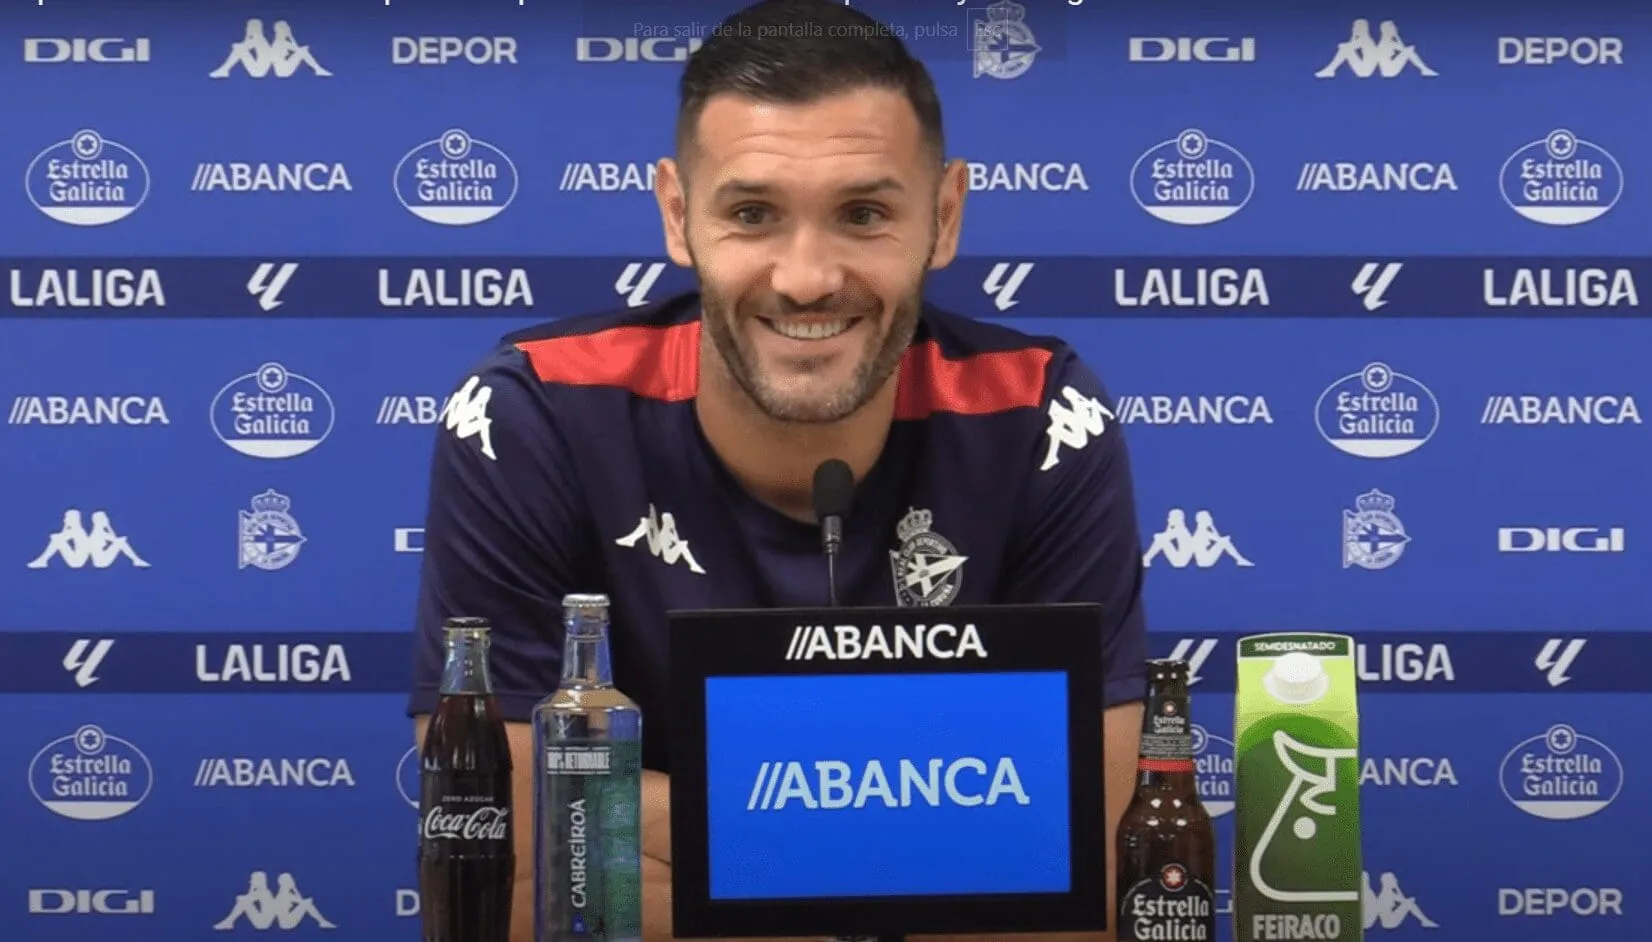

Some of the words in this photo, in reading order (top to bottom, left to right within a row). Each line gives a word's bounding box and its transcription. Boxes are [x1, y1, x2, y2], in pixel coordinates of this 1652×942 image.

[24, 38, 150, 62] DIGI
[392, 37, 518, 65] DEPOR
[1129, 37, 1255, 62] DIGI
[1498, 37, 1623, 65] DEPOR
[47, 159, 129, 180] Estrella
[415, 159, 497, 180] Estrella
[967, 162, 1089, 191] BANCA
[1151, 159, 1233, 180] Estrella
[1520, 159, 1602, 180] Estrella
[49, 181, 124, 203] Galicia
[418, 181, 493, 203] Galicia
[1154, 180, 1229, 202] Galicia
[1523, 180, 1598, 202] Galicia
[11, 268, 165, 307] LALIGA
[379, 268, 533, 307] LALIGA
[1115, 268, 1269, 307] LALIGA
[1484, 268, 1638, 307] LALIGA
[231, 392, 313, 413] Estrella
[1336, 392, 1418, 413] Estrella
[235, 414, 310, 436] Galicia
[1339, 413, 1414, 435] Galicia
[1498, 527, 1624, 552] DIGI
[1254, 642, 1336, 652] SEMIDESNATADO
[196, 644, 351, 682] LALIGA
[1357, 643, 1454, 681] LIGA
[50, 754, 131, 775] Estrella
[1359, 757, 1459, 786] ANCA
[1520, 754, 1602, 774] Estrella
[52, 776, 128, 797] Galicia
[1523, 775, 1598, 796] Galicia
[28, 889, 154, 914] DIGI
[1132, 893, 1209, 917] Estrella
[1498, 887, 1622, 915] DEPOR
[1134, 917, 1207, 941] Galicia
